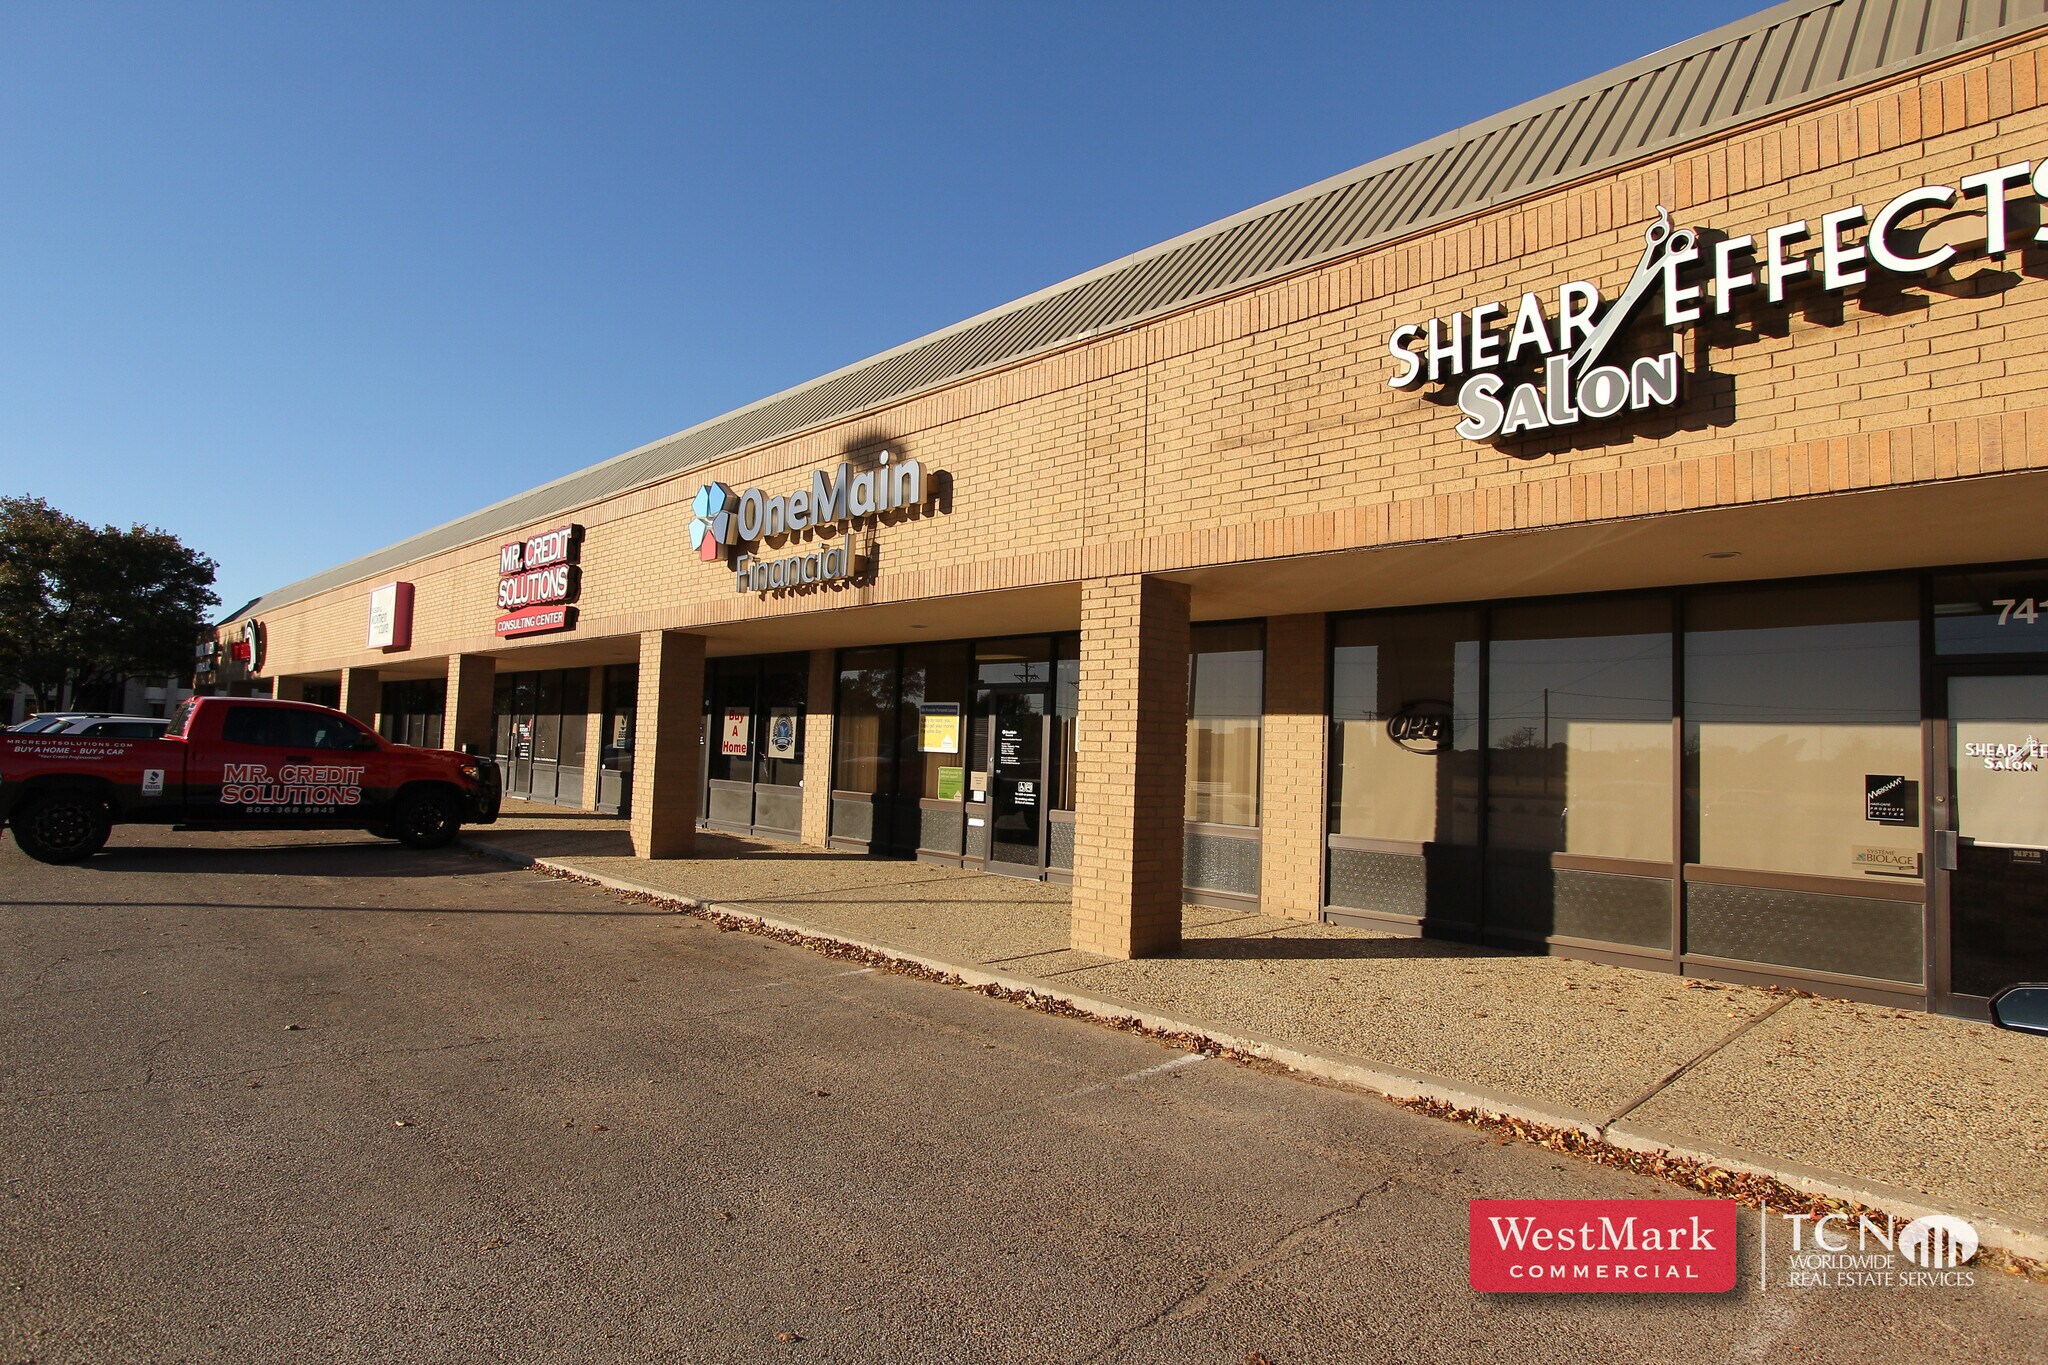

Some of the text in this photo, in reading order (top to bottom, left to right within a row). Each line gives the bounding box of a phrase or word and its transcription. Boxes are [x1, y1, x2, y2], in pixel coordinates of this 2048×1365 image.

[1388, 157, 2048, 389] SHEAR EFFECT
[738, 450, 922, 541] OneMain
[500, 527, 573, 573] MR. CREDIT
[736, 533, 851, 593] Financial
[498, 565, 569, 607] SOLUTIONS
[497, 611, 563, 632] CONSULTING CENTER
[729, 710, 745, 723] Buy
[732, 725, 738, 736] A
[7, 739, 133, 747] MRCREDITSOLUTIONS.COM
[723, 740, 747, 753] Home
[1965, 742, 2017, 757] SHEAR
[223, 764, 365, 785] MR. CREDIT
[220, 784, 361, 805] SOLUTIONS
[1866, 854, 1913, 865] BIOLAGE
